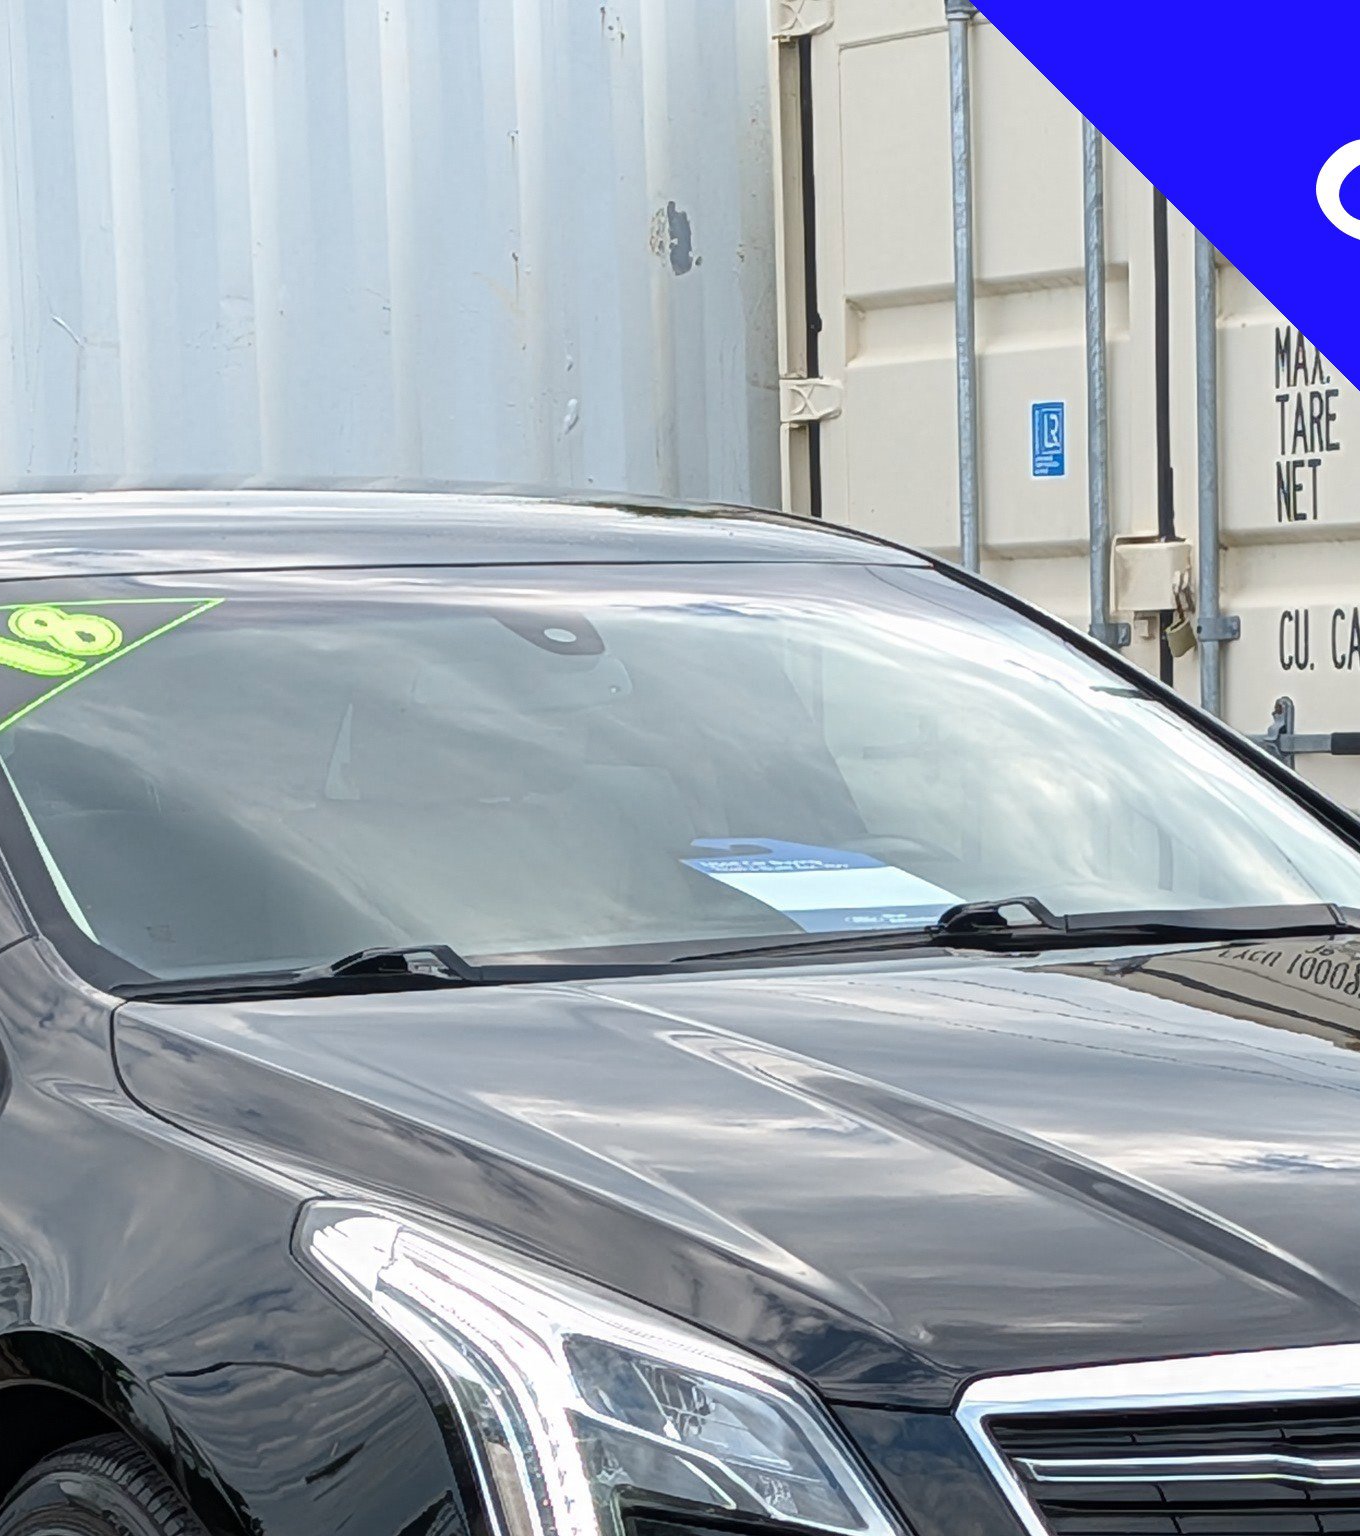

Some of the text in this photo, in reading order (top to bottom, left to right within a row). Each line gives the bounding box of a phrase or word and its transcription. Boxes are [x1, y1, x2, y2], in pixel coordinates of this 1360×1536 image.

[1275, 389, 1341, 455] TARE
[1276, 458, 1322, 522] NET
[1279, 608, 1314, 671] CU.
